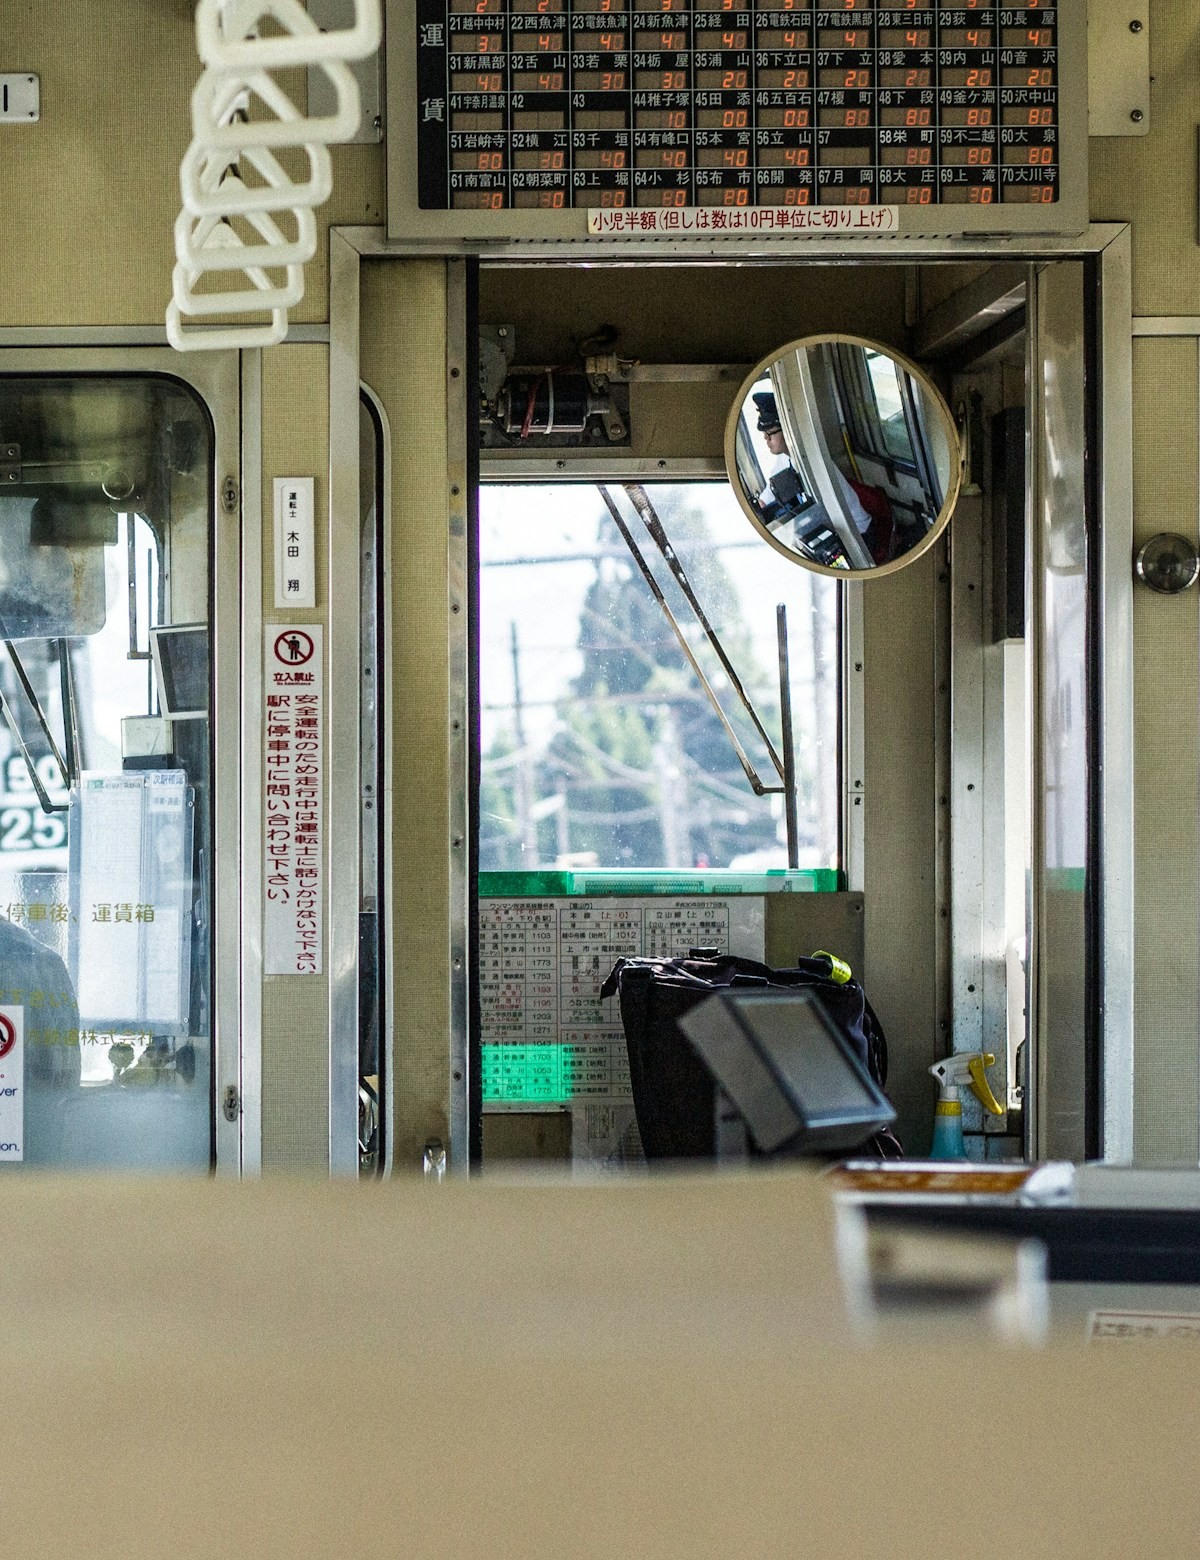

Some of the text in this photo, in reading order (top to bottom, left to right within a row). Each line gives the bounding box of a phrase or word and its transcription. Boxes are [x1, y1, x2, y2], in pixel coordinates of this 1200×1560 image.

[512, 94, 524, 108] 42
[573, 93, 585, 108] 43
[818, 131, 830, 145] 57
[273, 672, 315, 682] 立入禁止
[267, 694, 290, 904] 駅に停車中に問い合わせ下さい。
[0, 807, 66, 849] 25
